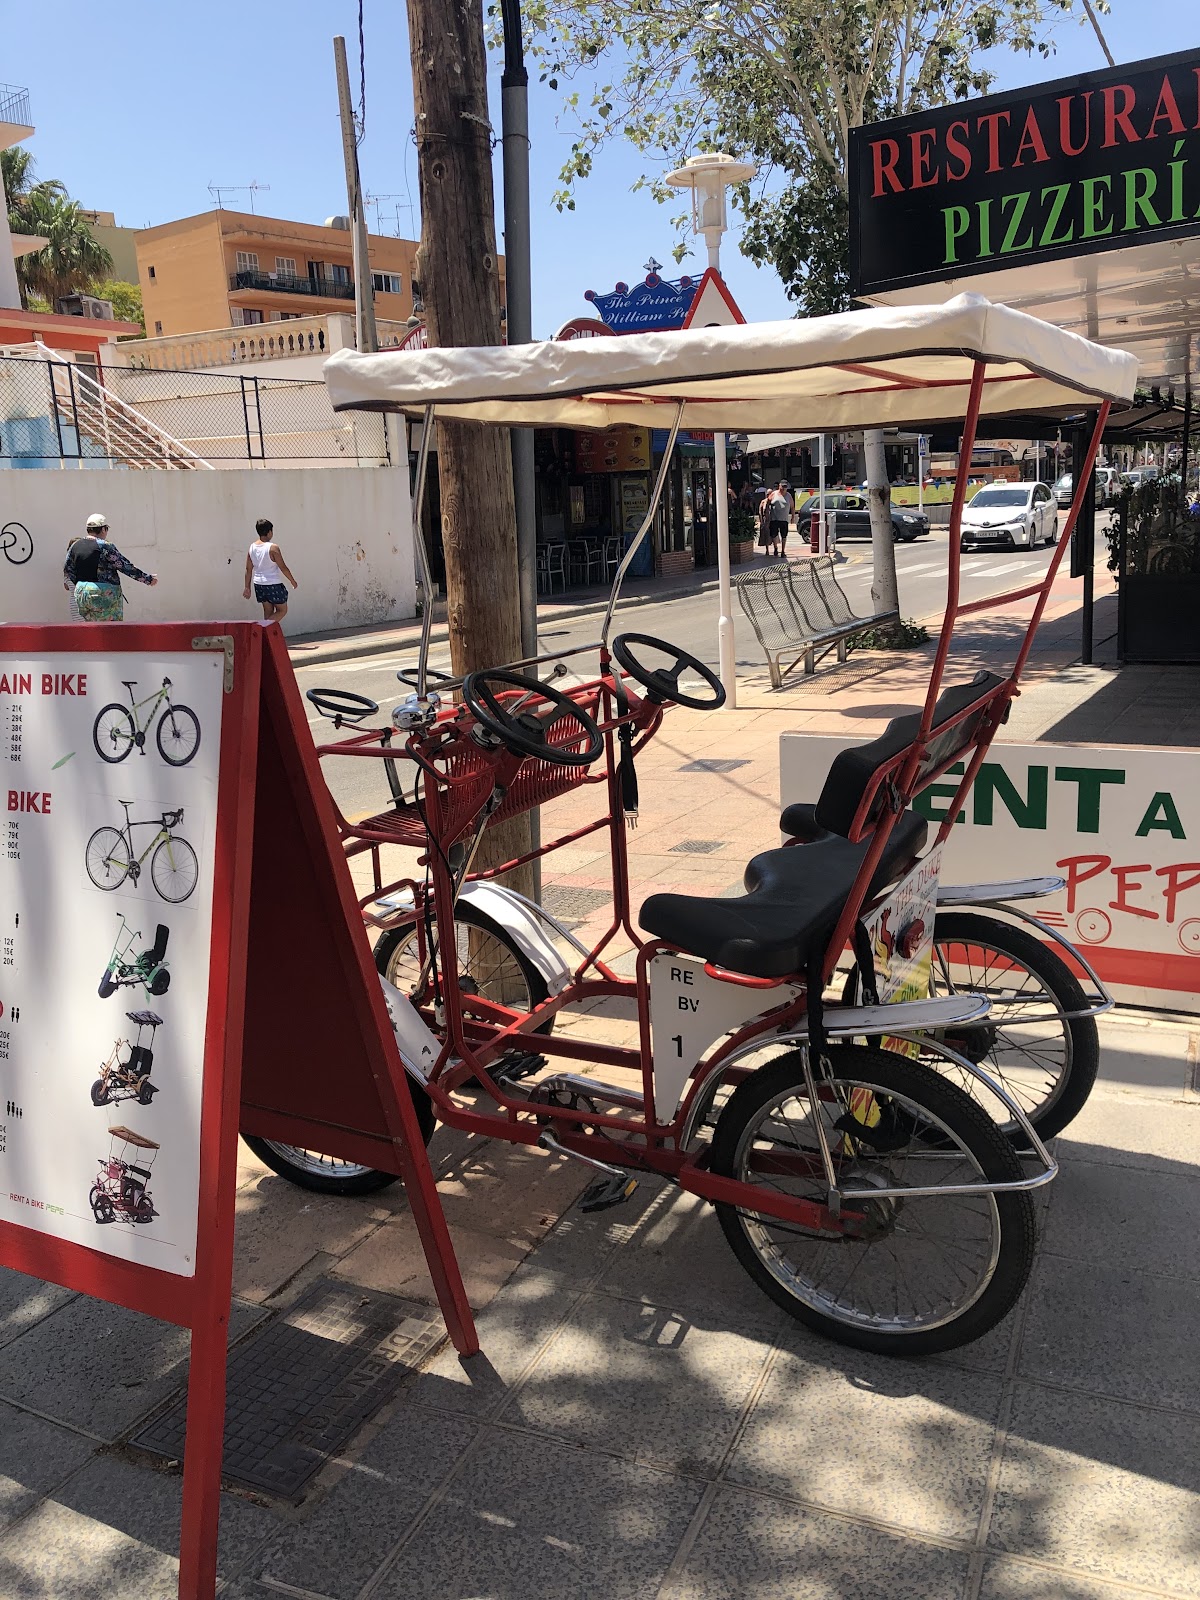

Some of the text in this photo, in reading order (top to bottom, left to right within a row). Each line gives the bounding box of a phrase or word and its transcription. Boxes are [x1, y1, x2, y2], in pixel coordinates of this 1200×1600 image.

[868, 67, 1200, 198] RESTAURA
[939, 139, 1200, 265] PIZZERÍ
[604, 292, 685, 310] The Prince
[603, 306, 690, 325] William Pu
[41, 673, 88, 696] BIKE
[12, 704, 22, 713] 21€
[11, 714, 23, 723] 29€
[11, 724, 23, 733] 38€
[11, 734, 22, 743] 48€
[11, 744, 22, 752] 58€
[7, 790, 52, 815] BIKE
[911, 761, 1188, 840] ENT A
[8, 821, 19, 830] 70€
[8, 831, 19, 840] 79€
[7, 841, 19, 850] 90€
[7, 851, 21, 860] 105€
[894, 878, 915, 917] THE
[916, 850, 943, 892] DUKE
[4, 937, 14, 946] 12€
[4, 947, 14, 956] 15€
[3, 957, 14, 966] 20€
[670, 966, 695, 986] RE
[671, 1034, 683, 1058] 1
[9, 1192, 65, 1216] RENT A BIKE PEPE
